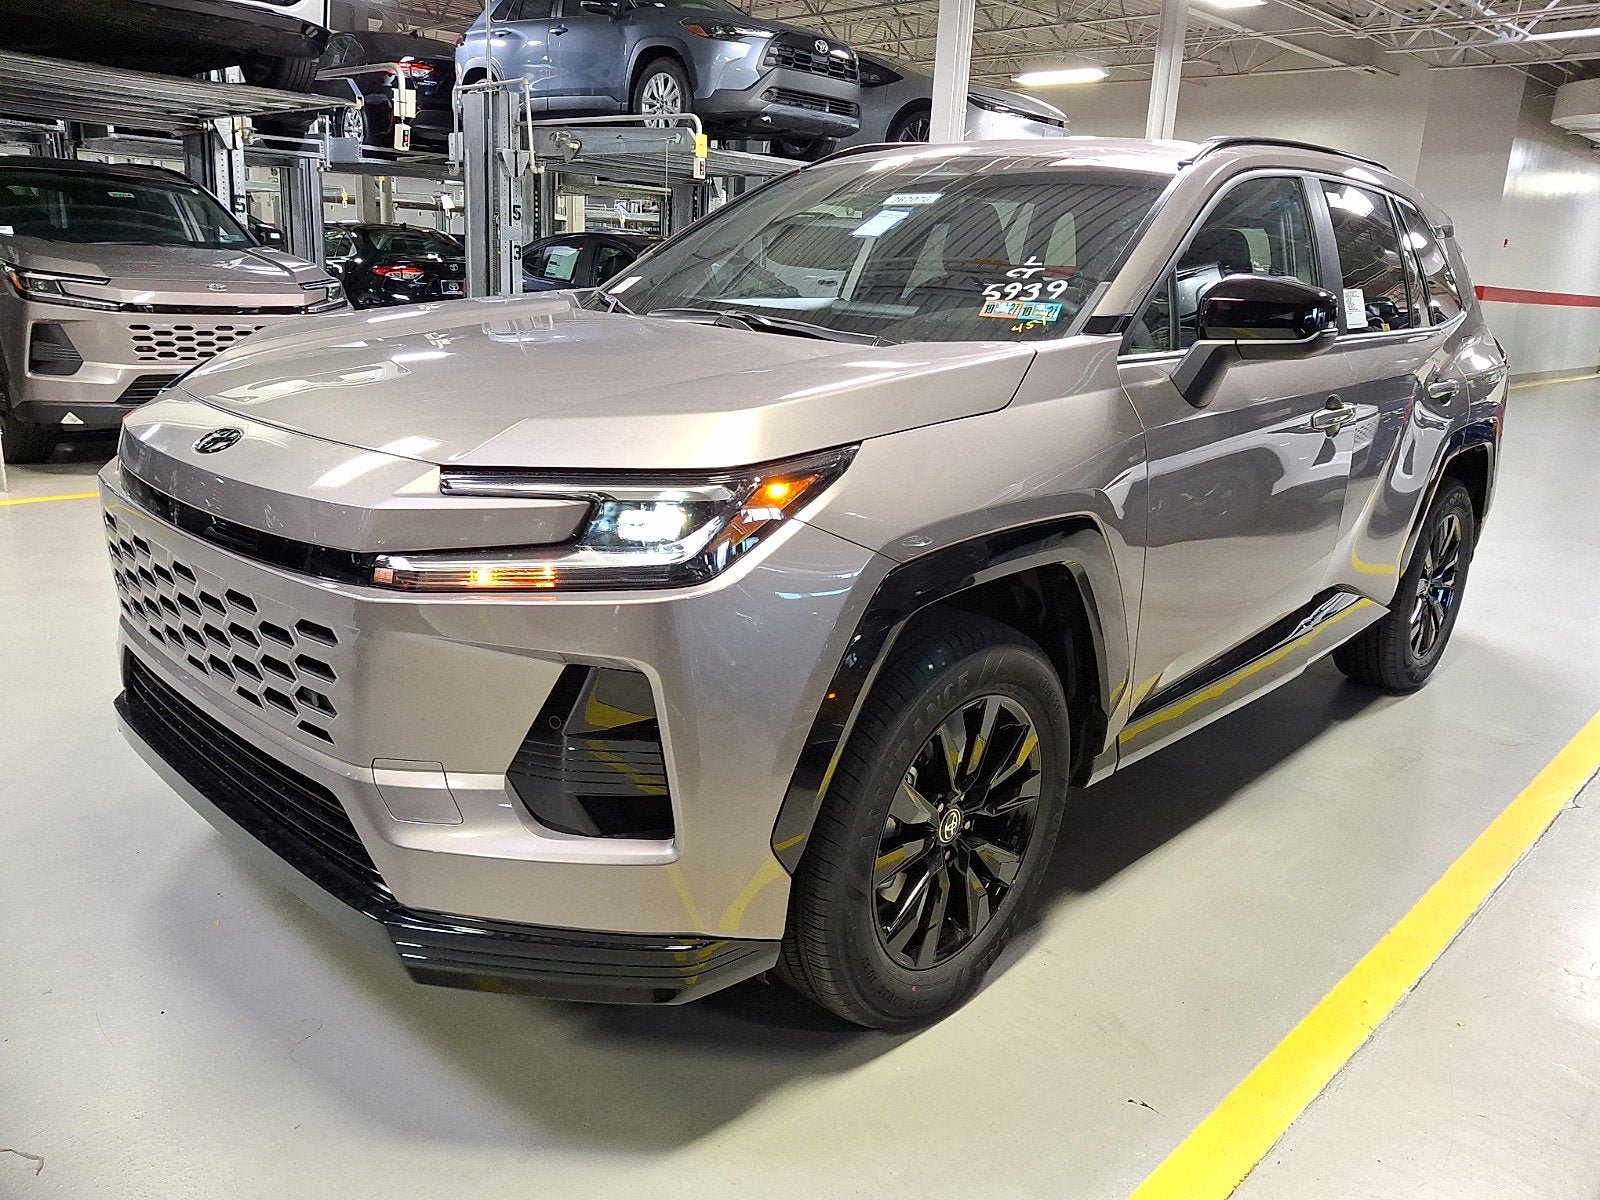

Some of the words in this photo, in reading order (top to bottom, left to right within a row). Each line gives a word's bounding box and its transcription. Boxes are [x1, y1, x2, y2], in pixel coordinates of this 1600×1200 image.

[234, 194, 246, 213] 5
[512, 204, 522, 221] 5
[513, 244, 522, 261] 3
[981, 279, 1069, 301] 5939
